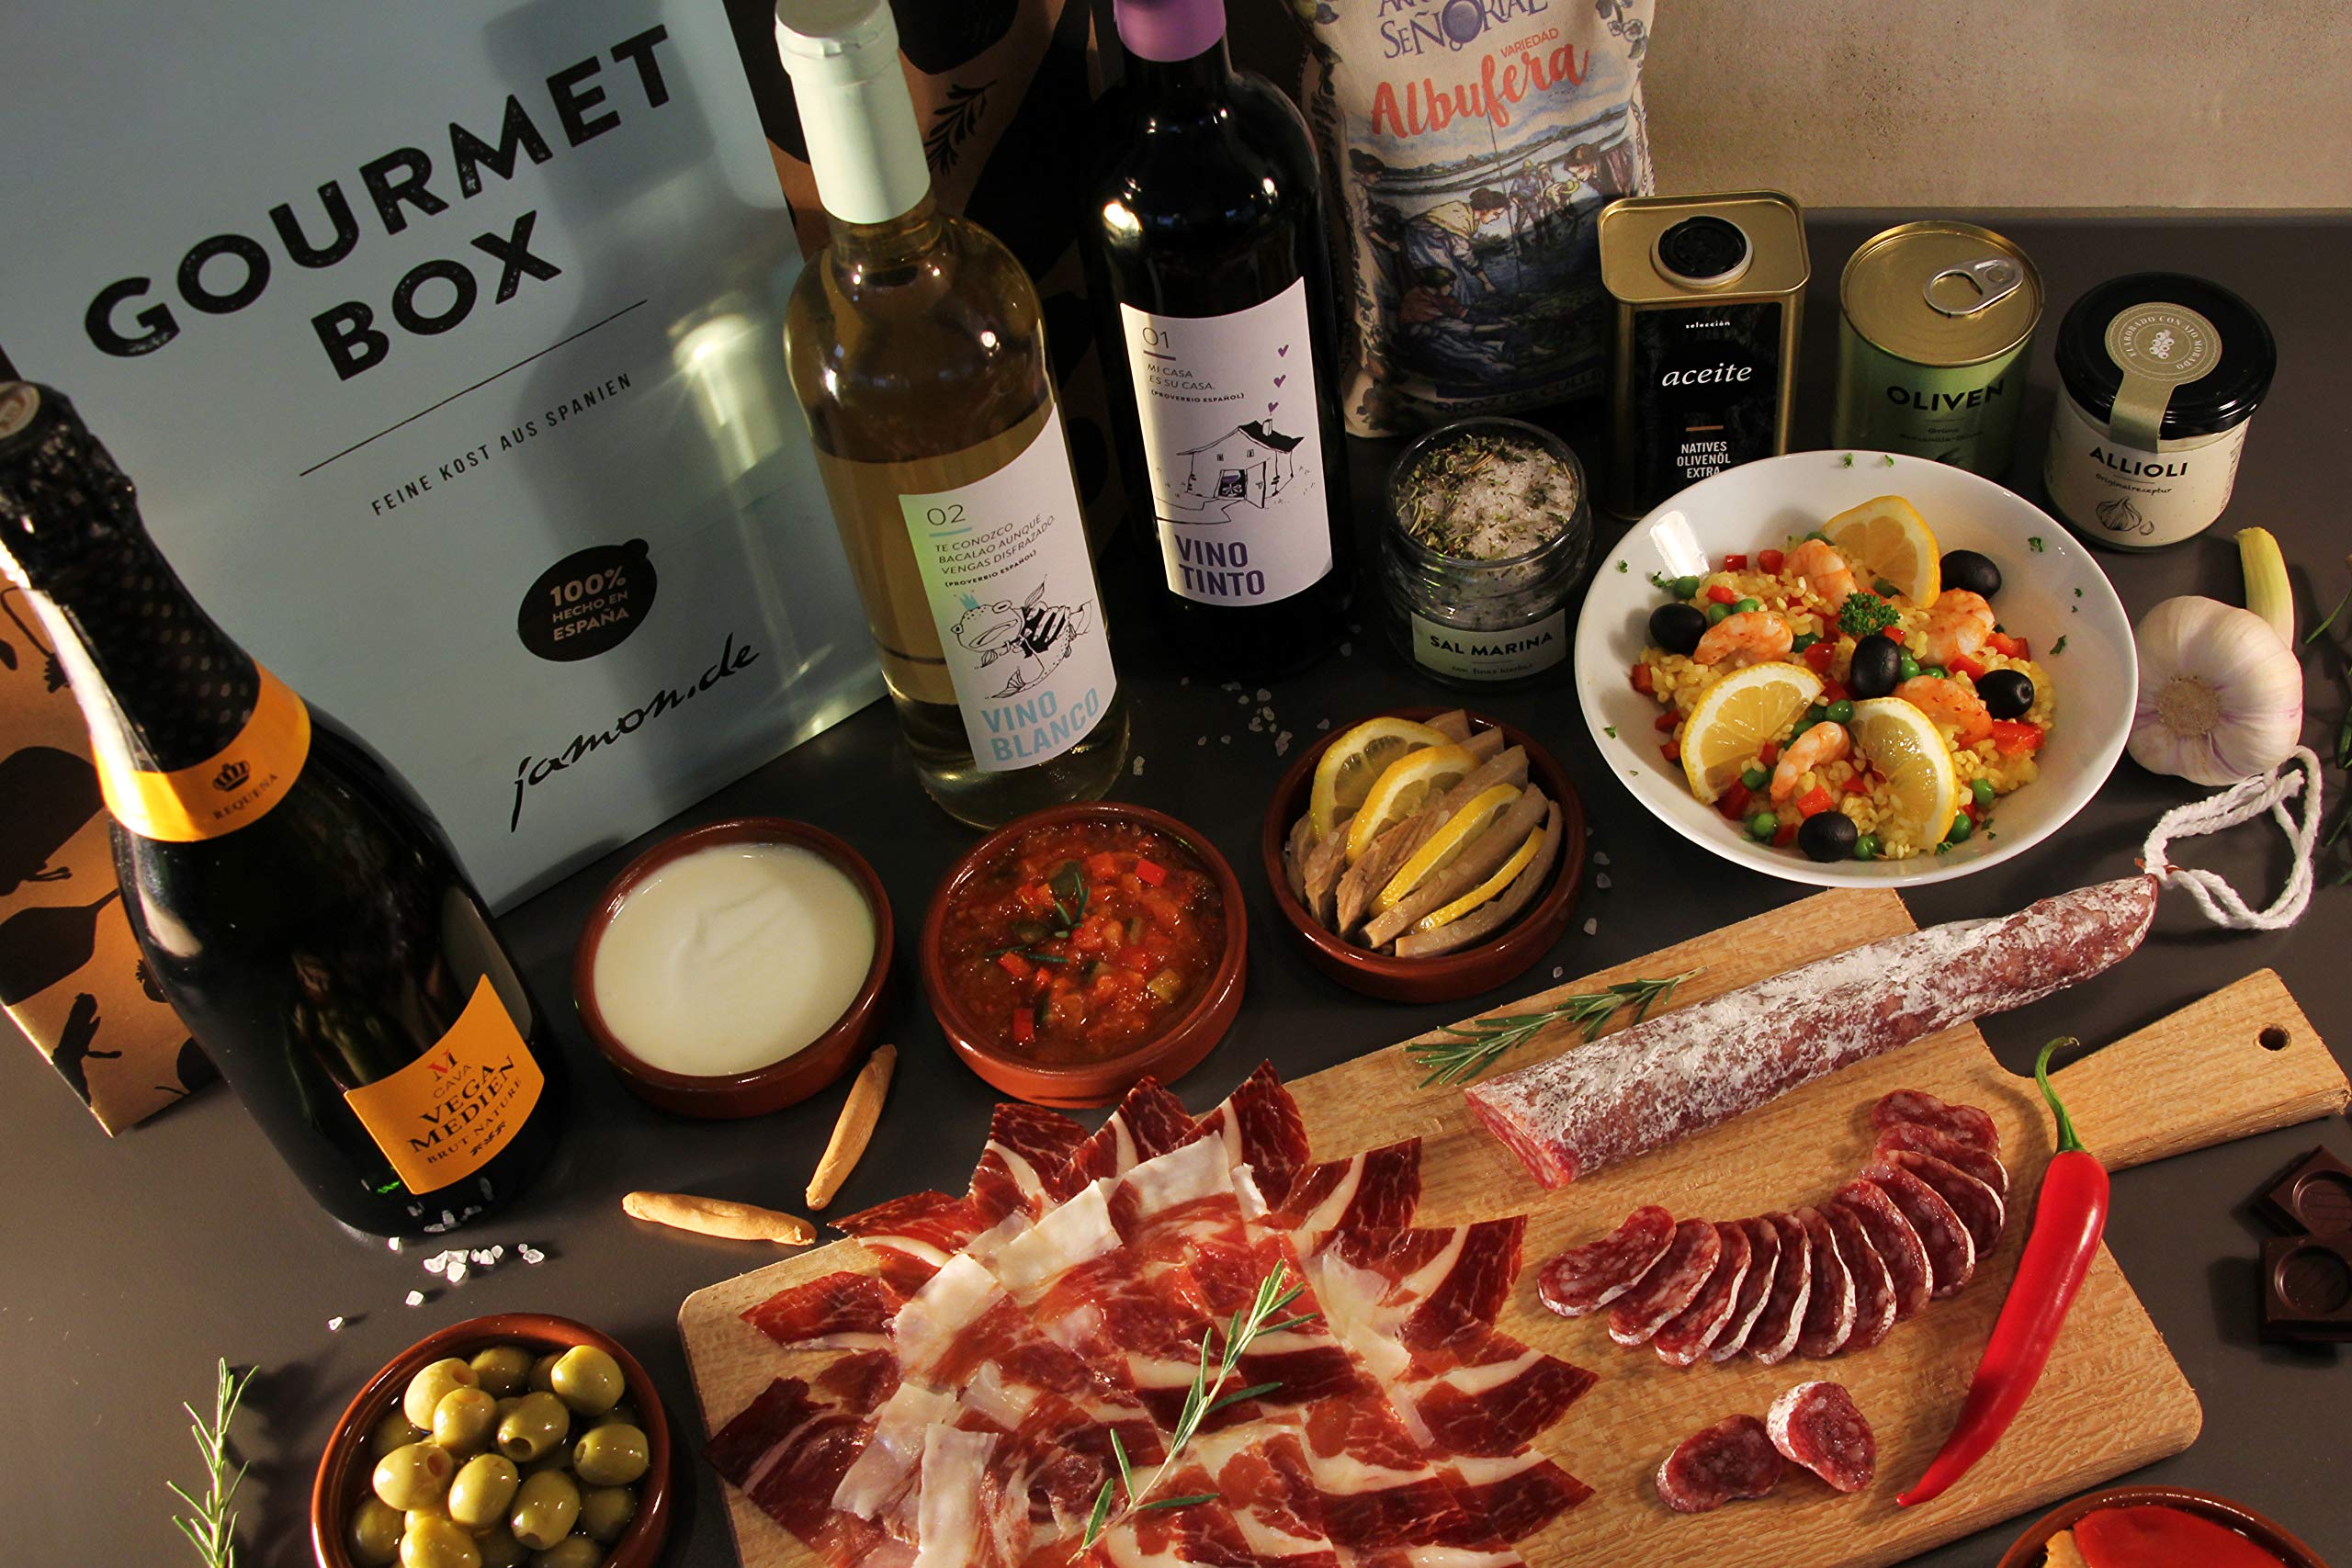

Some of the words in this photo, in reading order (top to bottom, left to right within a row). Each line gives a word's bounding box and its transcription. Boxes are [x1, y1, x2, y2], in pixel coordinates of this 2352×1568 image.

[1499, 28, 1559, 58] VARIEDAD
[1370, 42, 1590, 139] Albufera
[85, 24, 669, 357] GOURMET
[310, 209, 562, 381] BOX
[1142, 326, 1170, 349] 01
[1685, 320, 1731, 329] selección
[2158, 315, 2182, 326] CON
[2176, 340, 2203, 370] MORADO
[1147, 363, 1160, 374] MI
[1162, 367, 1193, 378] CASA
[1149, 375, 1162, 385] ES
[1164, 378, 1179, 389] SU
[1182, 381, 1216, 390] CASA.
[1661, 362, 1752, 387] aceite
[1151, 389, 1201, 403] (PROVERBIO
[1886, 377, 2004, 412] OLIVEN
[371, 474, 433, 516] FEINE
[438, 444, 492, 482] KOST
[500, 421, 538, 452] AUS
[547, 372, 633, 428] SPANIEN
[1677, 453, 1732, 468] OLIVENÖL
[1680, 441, 1728, 455] NATIVES
[1686, 467, 1721, 479] EXTRA
[2089, 446, 2188, 478] ALLIOLI
[926, 503, 967, 526] 02
[935, 543, 949, 552] TE
[952, 522, 1014, 551] CONOZCO
[939, 544, 996, 564] BACALAO
[998, 513, 1042, 549] AUNQUE
[1174, 534, 1248, 569] VINO
[941, 559, 991, 575] VENGAS
[944, 571, 999, 588] (PROVERBIO
[1178, 563, 1266, 597] TINTO
[549, 565, 627, 606] 100%
[552, 598, 605, 623] HECHO
[608, 590, 628, 604] EN
[553, 607, 629, 641] ESPAÑA
[1430, 635, 1465, 655] SAL
[1470, 631, 1554, 657] MARINA
[980, 691, 1058, 734] VINO
[990, 687, 1100, 763] BLANCO
[510, 631, 761, 833] jamon.de
[419, 1065, 497, 1124] VEGA
[433, 1065, 472, 1100] CAVA
[407, 1055, 515, 1154] MEDIEN
[427, 1135, 469, 1164] BRUT
[473, 1078, 522, 1136] NATURE
